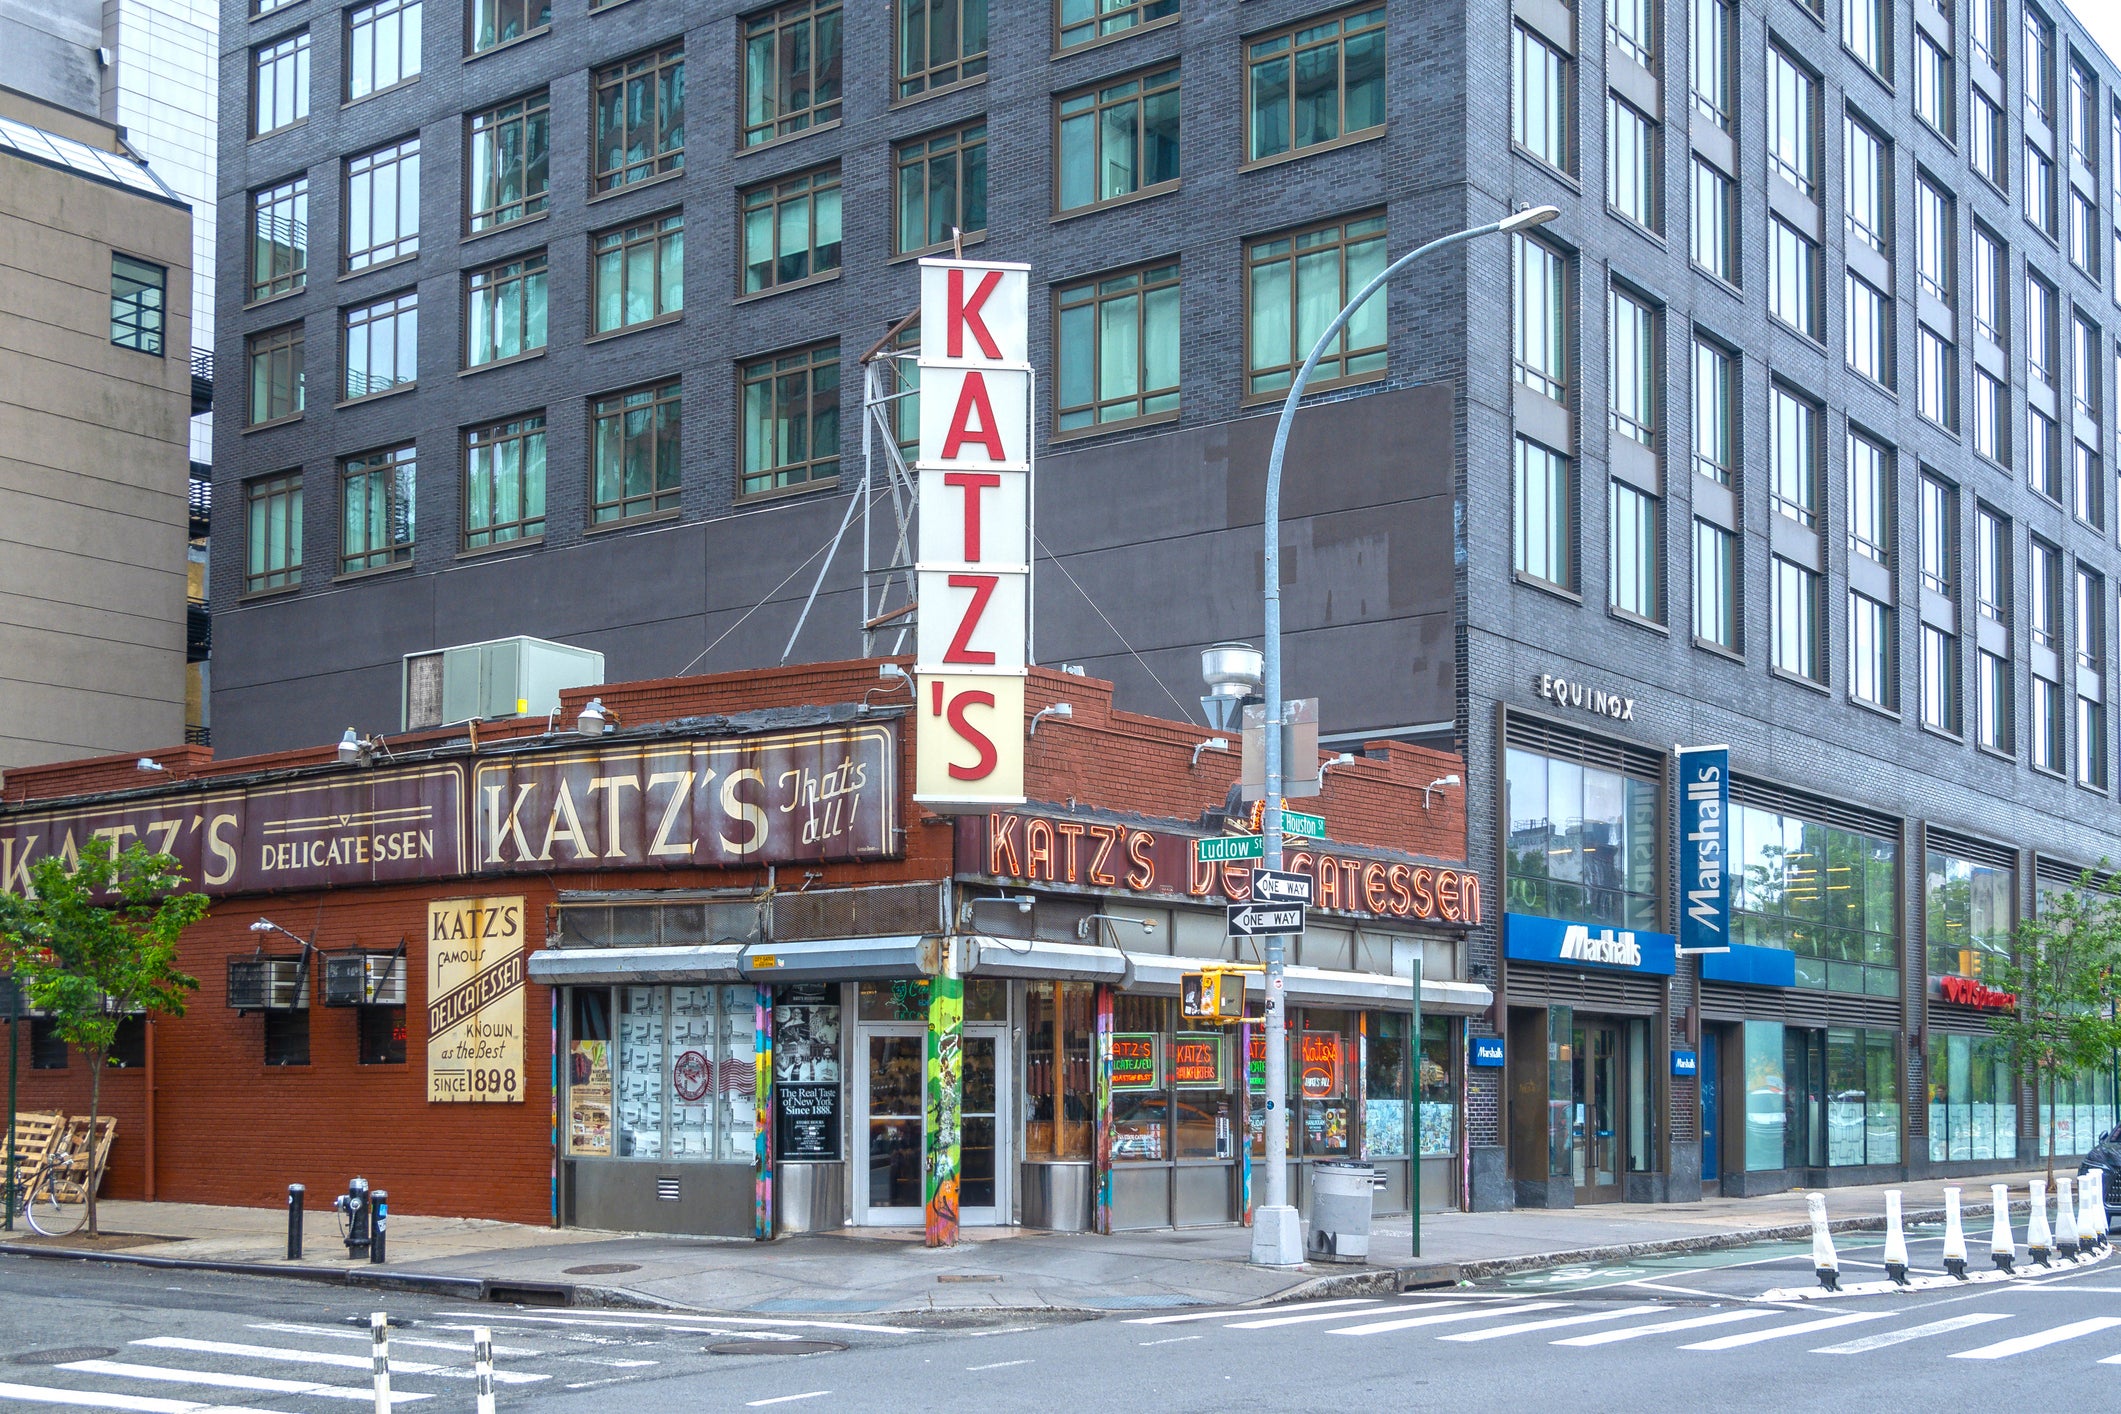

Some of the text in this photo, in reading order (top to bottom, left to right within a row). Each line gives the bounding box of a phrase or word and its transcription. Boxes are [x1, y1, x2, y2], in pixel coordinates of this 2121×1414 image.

[932, 268, 1006, 782] KATZ'S
[1540, 673, 1634, 721] EQUINOX
[779, 755, 867, 813] That's
[483, 766, 769, 863] KATZ'S
[1286, 813, 1316, 835] Houston
[1318, 820, 1324, 831] St
[0, 812, 239, 902] KATZ'S
[261, 829, 434, 871] DELICATESSEN
[990, 812, 1156, 891] KATZ'S
[1201, 838, 1264, 859] Ludlow St
[1688, 765, 1720, 933] Marshalls
[1190, 839, 1481, 923] DEATESSEN
[1262, 880, 1305, 896] ONE WAY
[432, 905, 518, 941] KATZ'S
[1243, 912, 1296, 926] ONE WAY
[1559, 925, 1642, 967] Marshalls
[430, 957, 521, 1034] DELICATESSEN
[466, 1022, 513, 1038] KNOWN
[441, 1039, 506, 1060] as the Best
[1177, 1043, 1212, 1063] KATZ'S
[1477, 1046, 1503, 1059] Marshalls
[1675, 1058, 1696, 1069] Marshalls
[433, 1077, 466, 1093] SINCE
[780, 1088, 836, 1098] The Real Taste
[783, 1097, 792, 1106] of
[793, 1098, 813, 1106] New
[786, 1106, 810, 1115] Since
